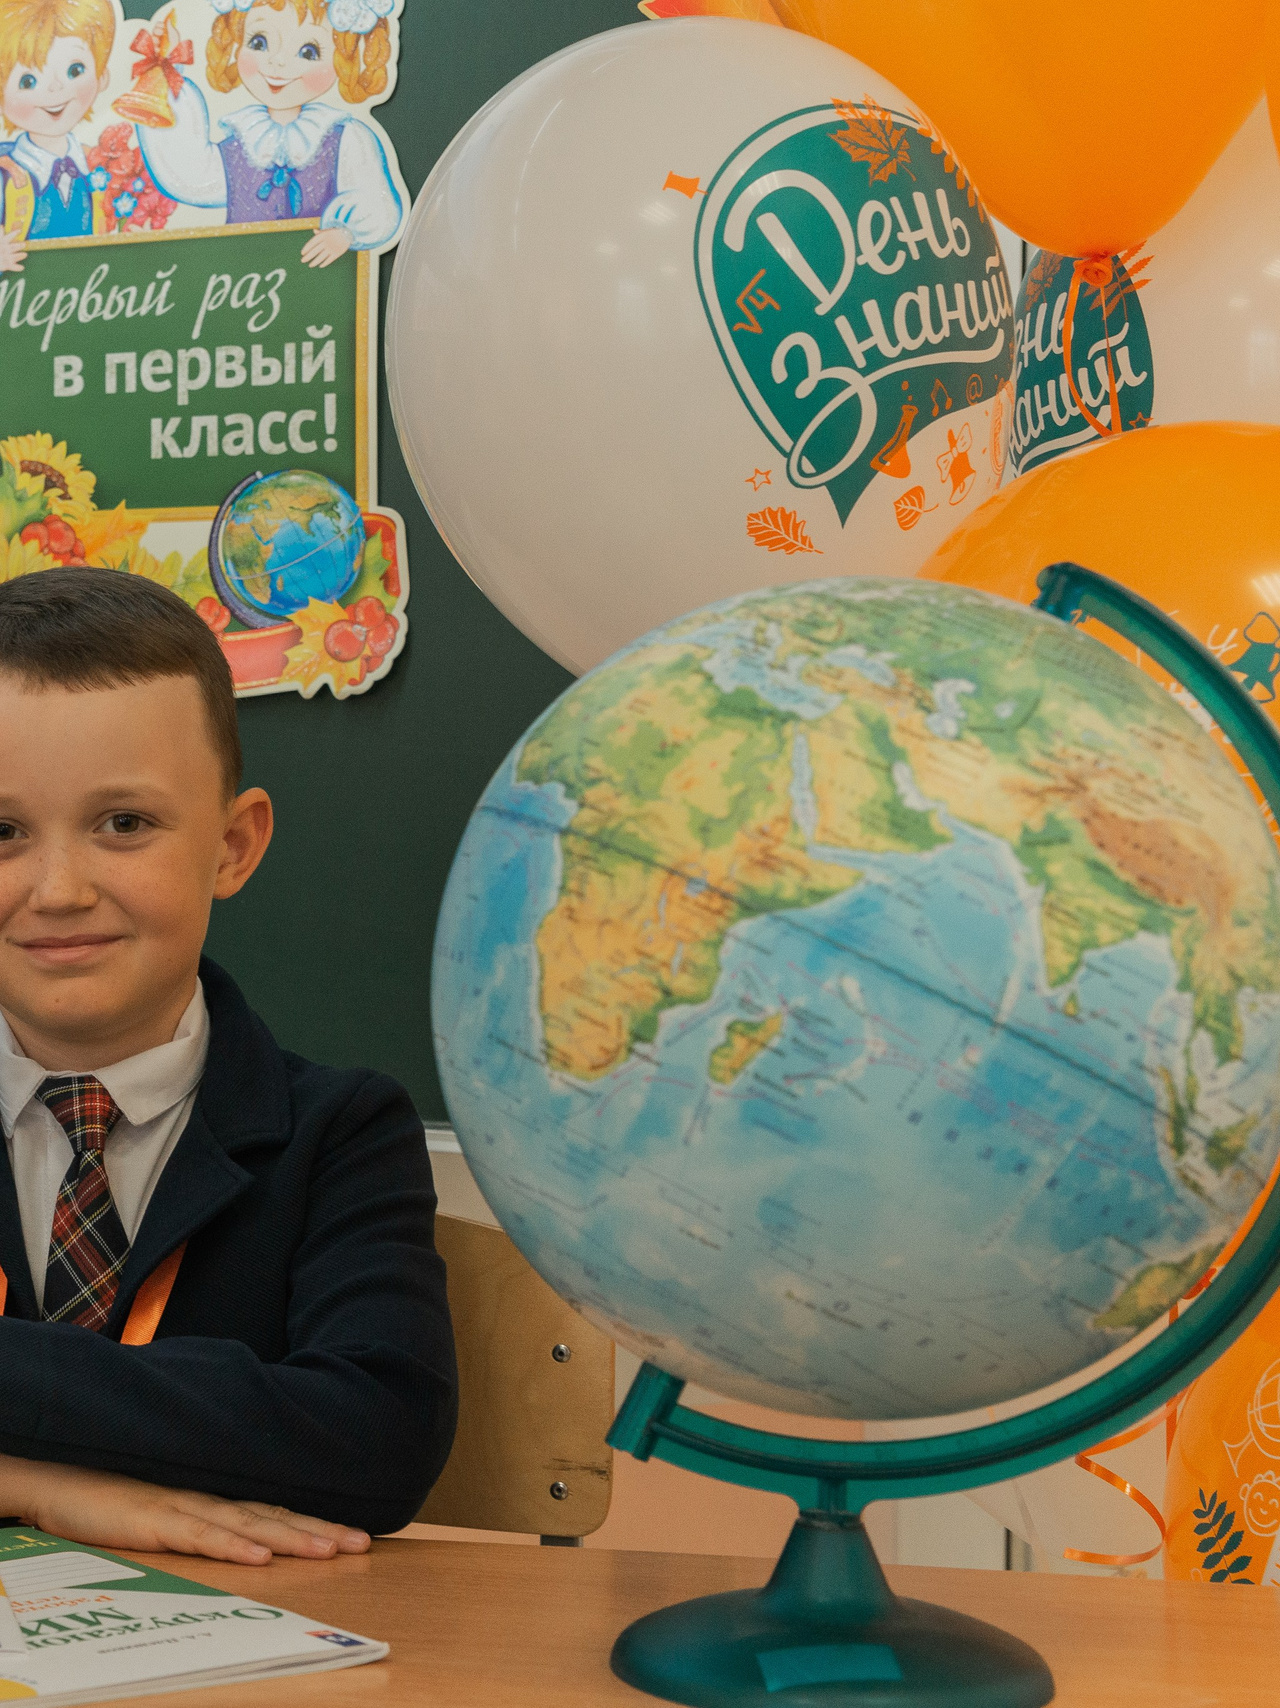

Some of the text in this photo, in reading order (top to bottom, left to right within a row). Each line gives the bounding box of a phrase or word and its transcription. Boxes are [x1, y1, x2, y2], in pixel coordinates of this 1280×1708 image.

[723, 169, 971, 315] День
[191, 267, 286, 339] раз
[53, 324, 336, 405] в первый
[771, 247, 1012, 487] Знаний
[150, 393, 338, 459] класс!
[11, 1594, 115, 1614] Рабоча
[25, 1607, 284, 1649] Окружаю
